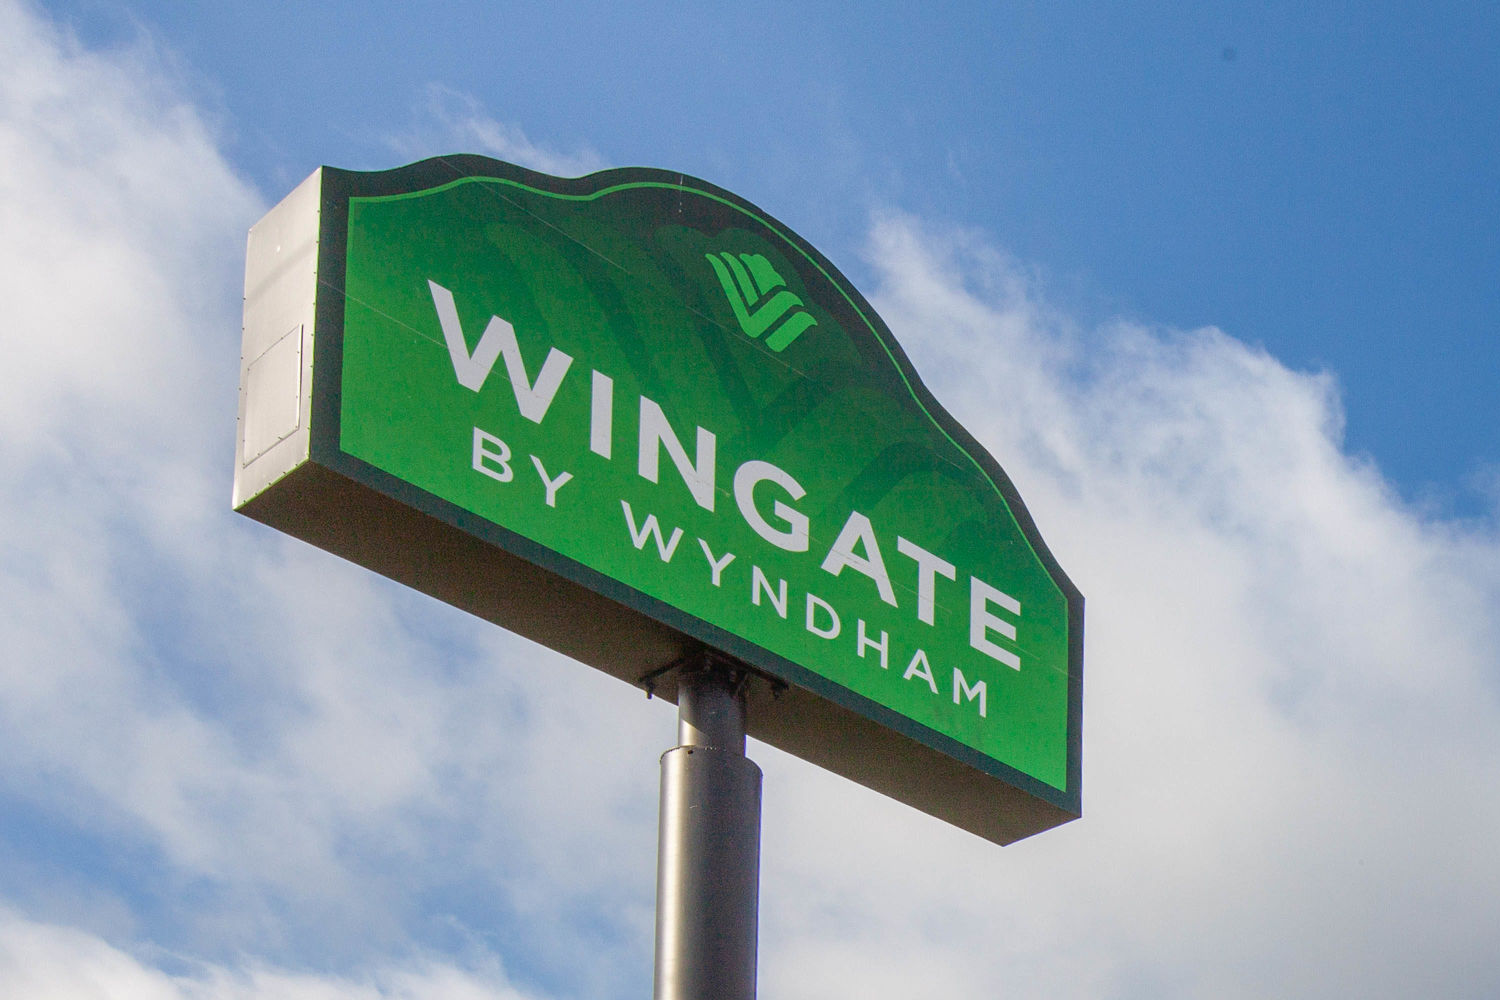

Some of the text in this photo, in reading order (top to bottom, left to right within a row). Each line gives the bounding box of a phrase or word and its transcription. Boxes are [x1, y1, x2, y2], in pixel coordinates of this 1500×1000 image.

[426, 278, 1022, 672] WINGATE
[471, 426, 988, 719] BY WYNDHAM
